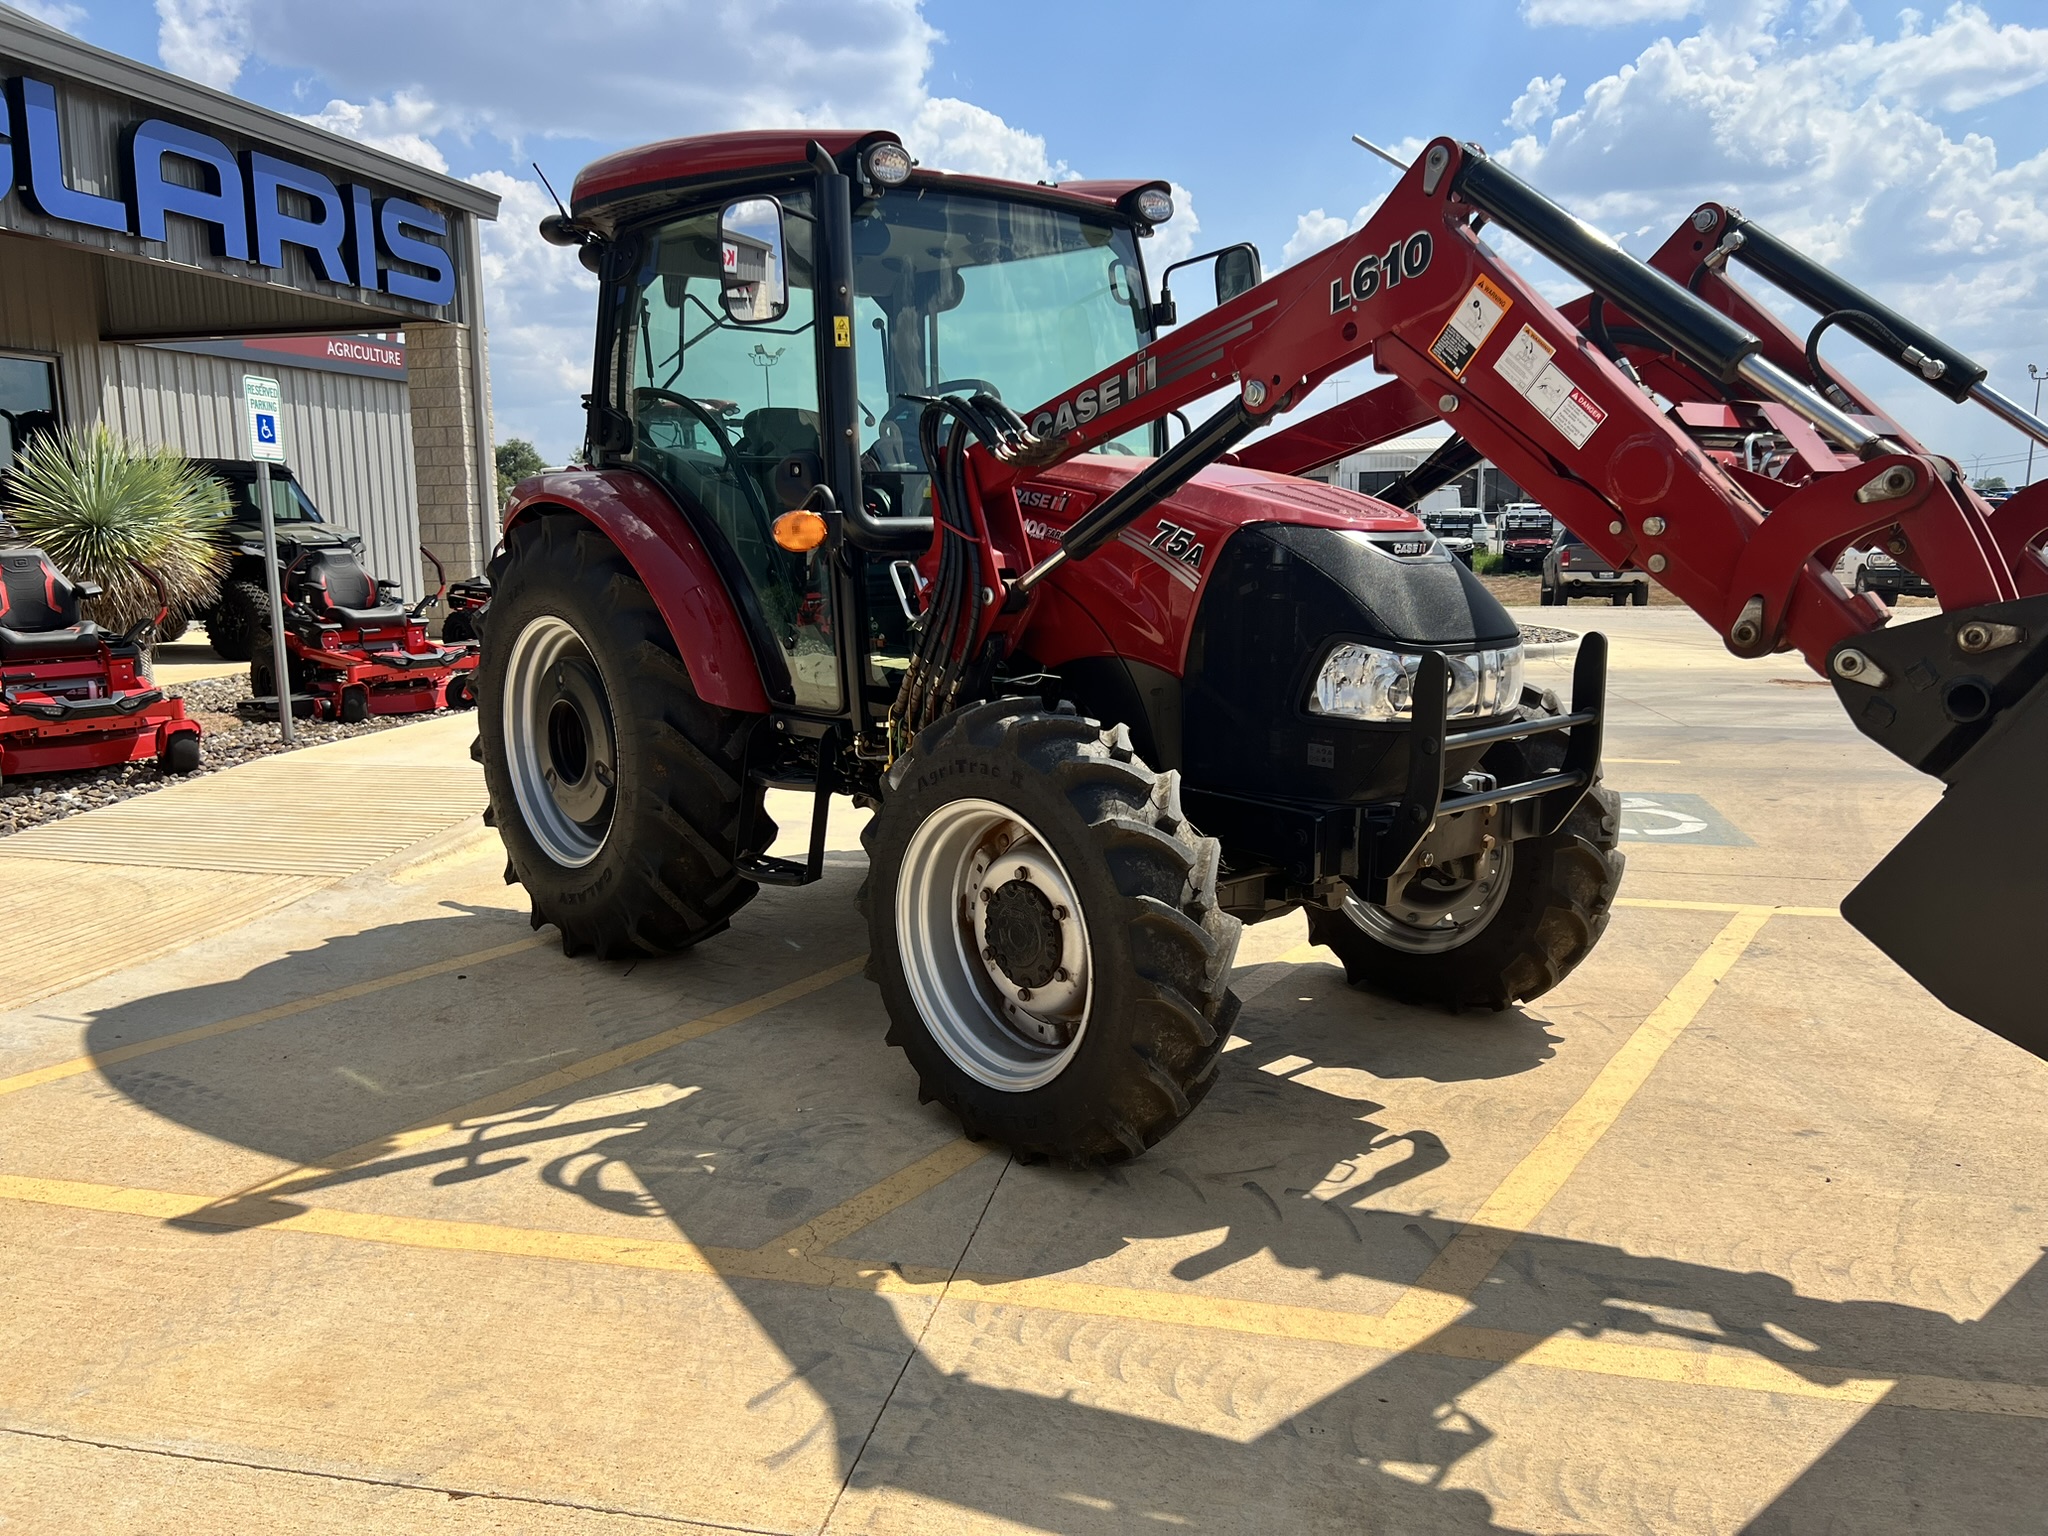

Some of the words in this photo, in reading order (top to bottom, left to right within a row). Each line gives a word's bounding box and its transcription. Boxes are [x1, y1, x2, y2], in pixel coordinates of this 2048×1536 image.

[0, 76, 456, 306] LARIS
[1329, 229, 1434, 316] L610
[1484, 285, 1507, 309] WARNING
[326, 340, 402, 367] AGRICULTURE
[246, 383, 279, 399] RESERVED
[250, 398, 278, 413] PARKING
[1031, 374, 1121, 438] CASE
[1577, 395, 1603, 421] DANGER
[1148, 518, 1205, 569] 75A
[1392, 542, 1419, 555] CASE
[917, 759, 1000, 792] AgriTrac
